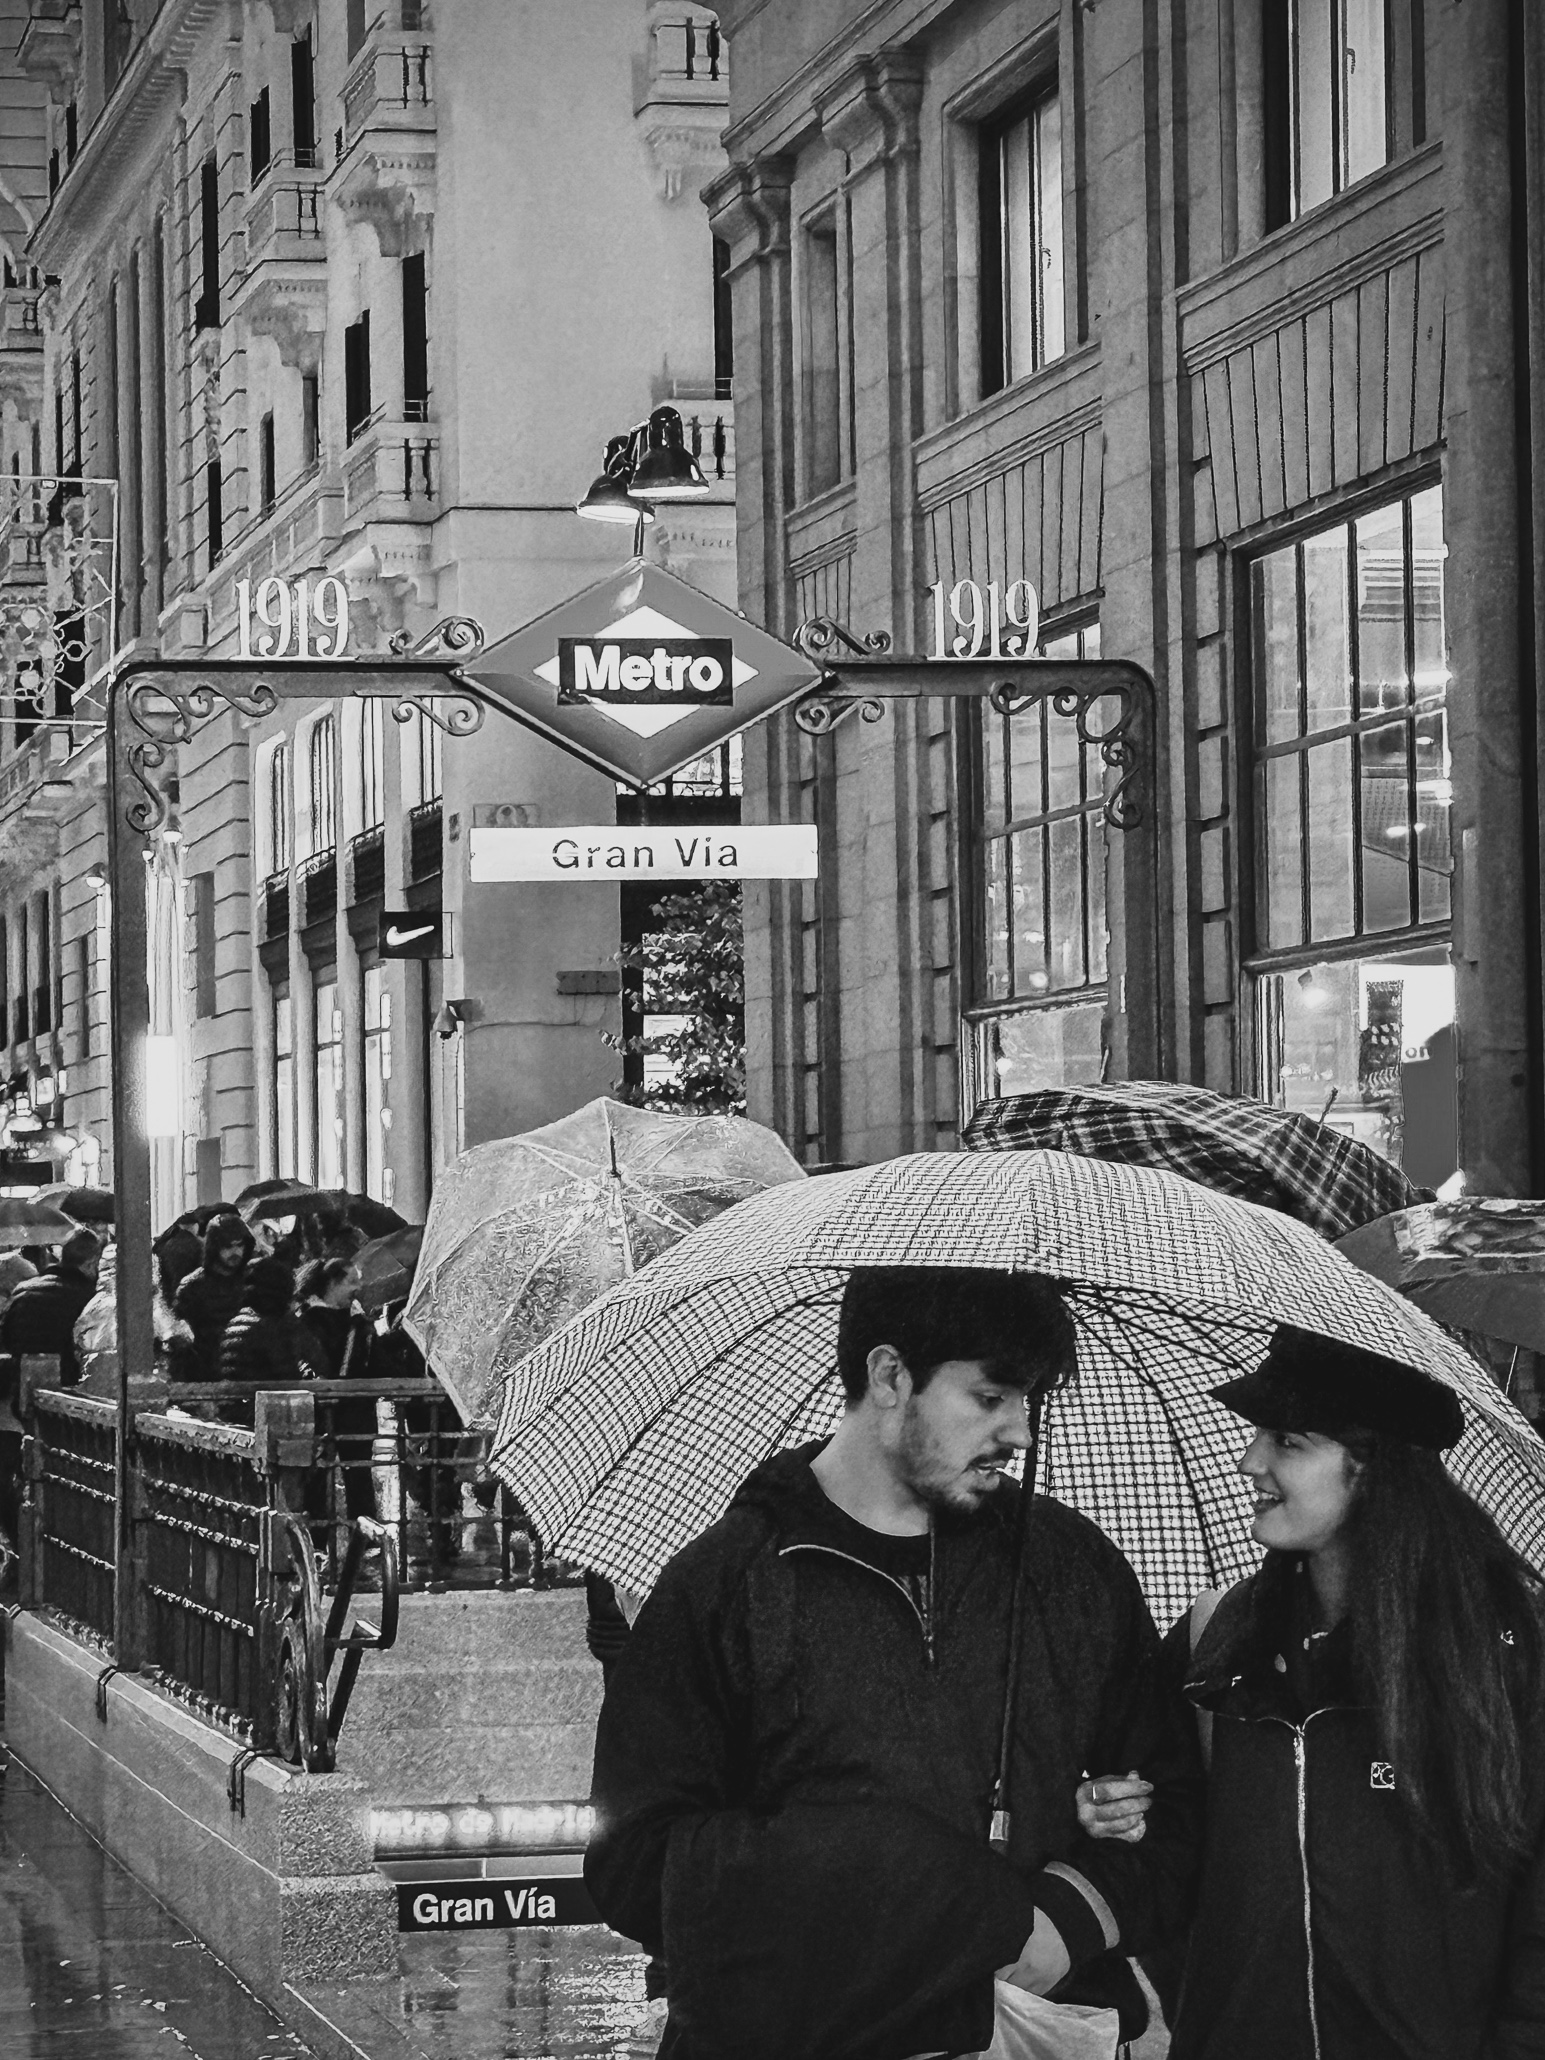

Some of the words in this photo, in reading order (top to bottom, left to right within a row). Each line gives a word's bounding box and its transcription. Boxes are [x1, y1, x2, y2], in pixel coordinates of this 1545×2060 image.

[235, 577, 349, 659] 1919
[929, 579, 1039, 659] 1919
[574, 645, 723, 692] Metro
[552, 839, 654, 868] Gran
[369, 1810, 449, 1838] Metro
[413, 1893, 494, 1924] Gran
[503, 1886, 556, 1919] Vía
